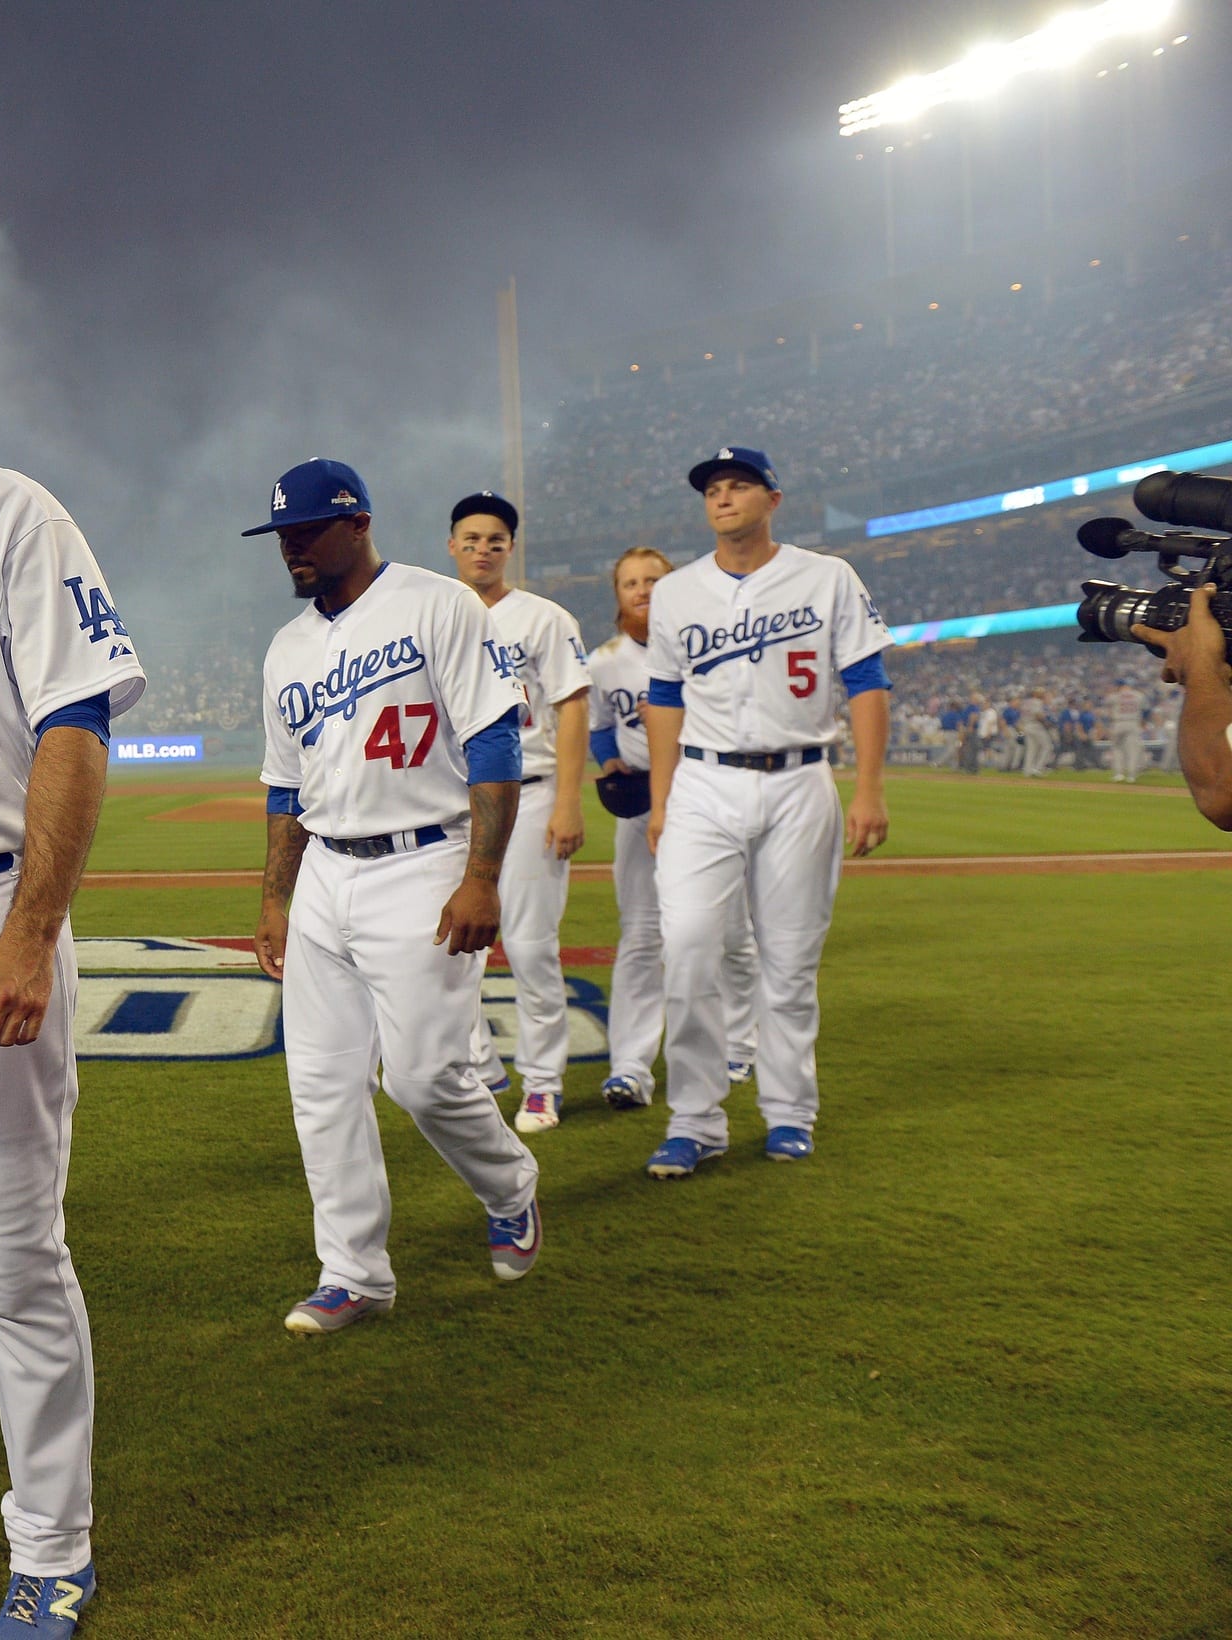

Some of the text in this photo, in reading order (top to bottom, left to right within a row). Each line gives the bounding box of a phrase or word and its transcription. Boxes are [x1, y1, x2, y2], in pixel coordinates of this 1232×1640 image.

[273, 482, 287, 511] LA
[63, 576, 130, 645] LA
[679, 605, 823, 668] Dodgers
[482, 639, 518, 679] LA
[787, 651, 817, 698] 5
[278, 635, 426, 740] Dodgers
[118, 743, 196, 759] MLB.com
[364, 701, 439, 770] 47
